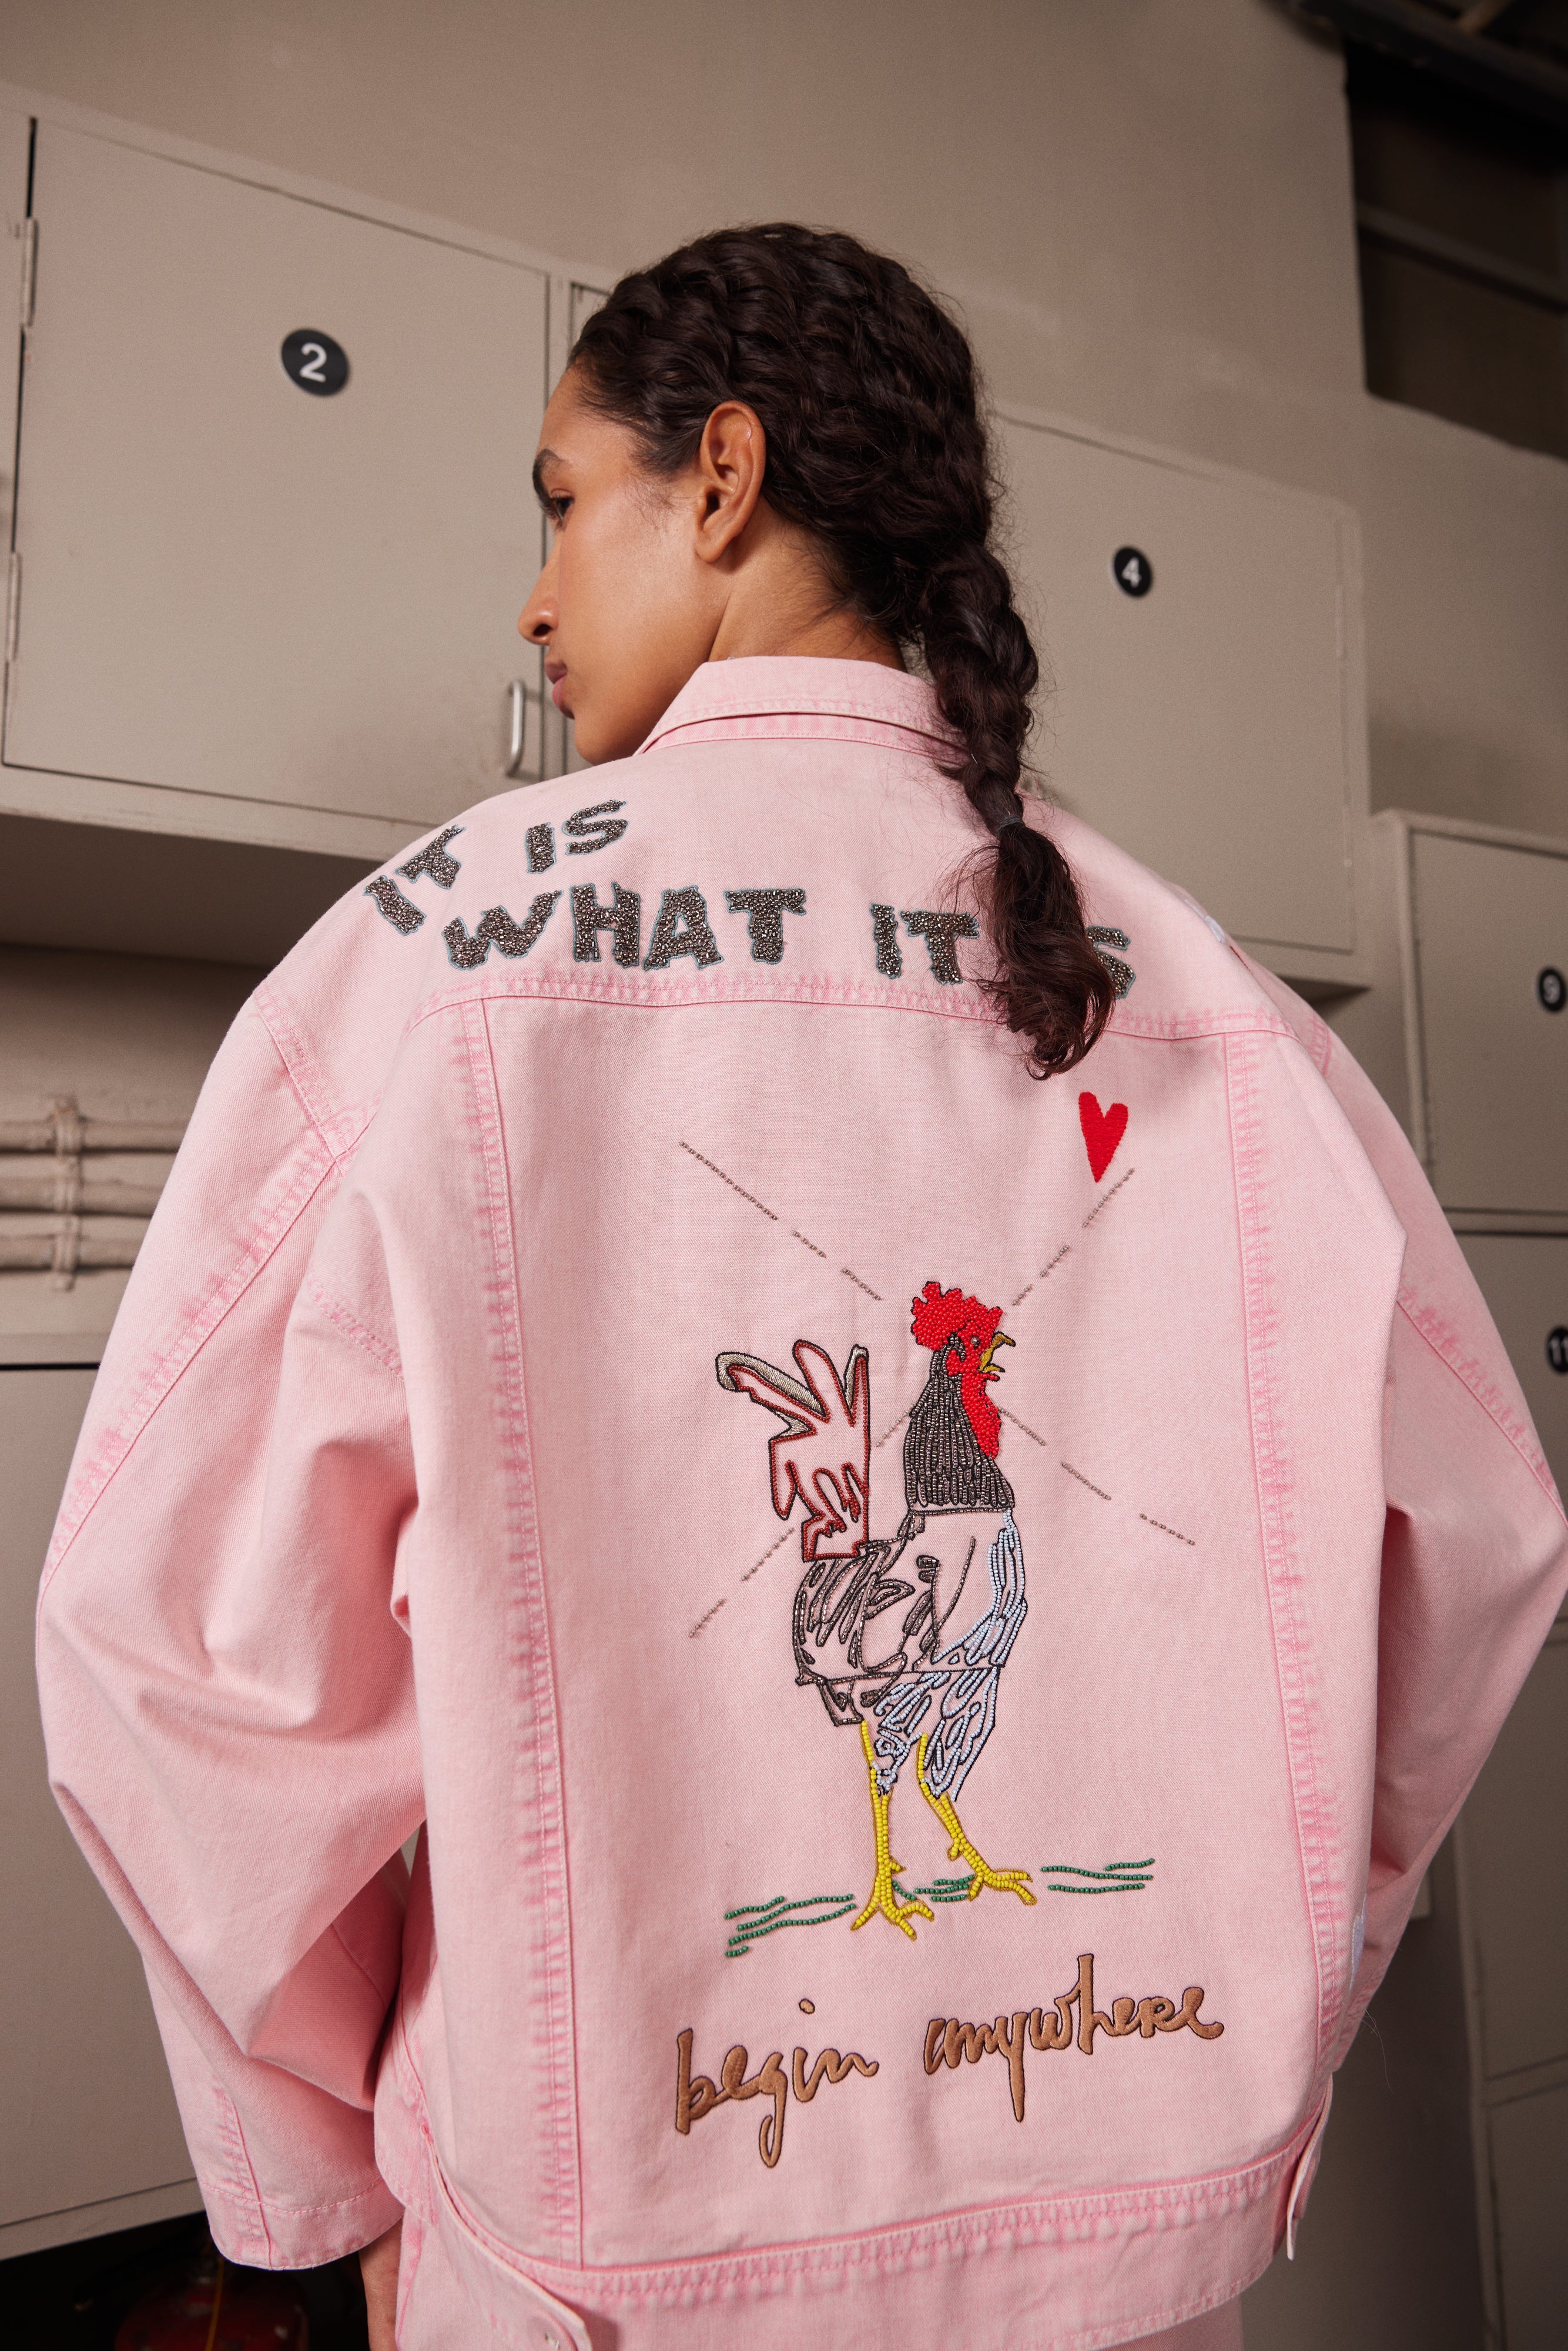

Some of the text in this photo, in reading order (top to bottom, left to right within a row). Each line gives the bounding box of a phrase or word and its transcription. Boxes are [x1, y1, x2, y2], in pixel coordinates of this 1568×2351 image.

[299, 341, 327, 383] 2
[1121, 556, 1142, 588] 4
[364, 799, 628, 936] IT IS
[441, 882, 1137, 999] WHAT IT S
[675, 1953, 1225, 2168] begin anywhere
